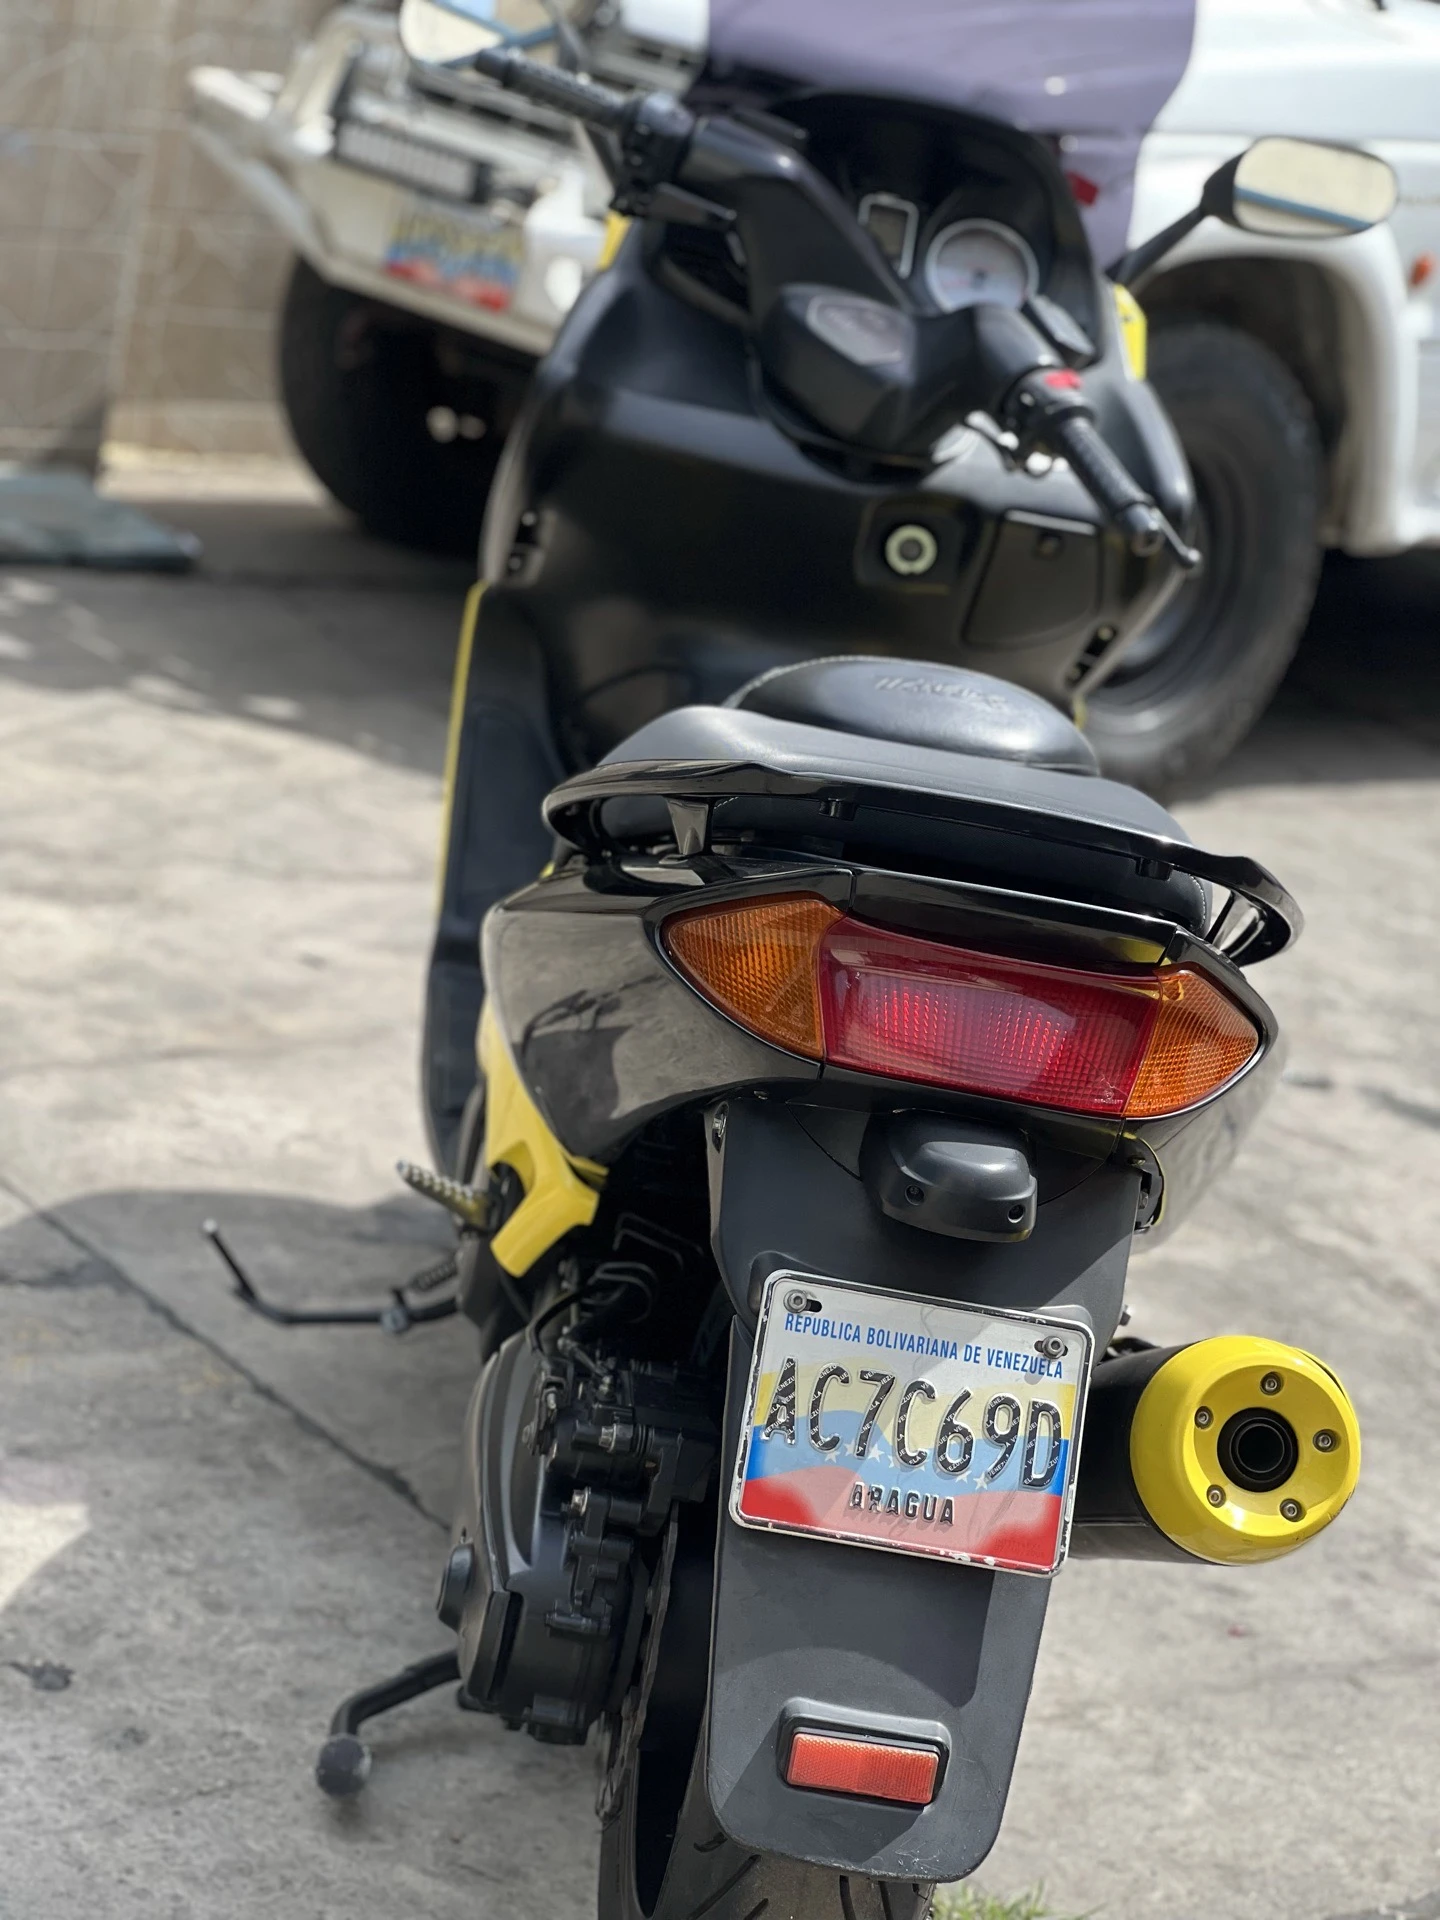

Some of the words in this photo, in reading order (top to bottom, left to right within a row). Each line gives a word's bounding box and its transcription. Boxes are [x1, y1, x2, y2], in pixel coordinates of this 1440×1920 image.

[784, 1312, 861, 1343] REPUBLICA
[866, 1326, 958, 1360] BOLIVARIANA
[963, 1343, 982, 1364] DE
[987, 1347, 1063, 1379] VENEZUELA
[760, 1357, 1064, 1489] AC7C69D
[850, 1481, 955, 1526] ARAGUA
